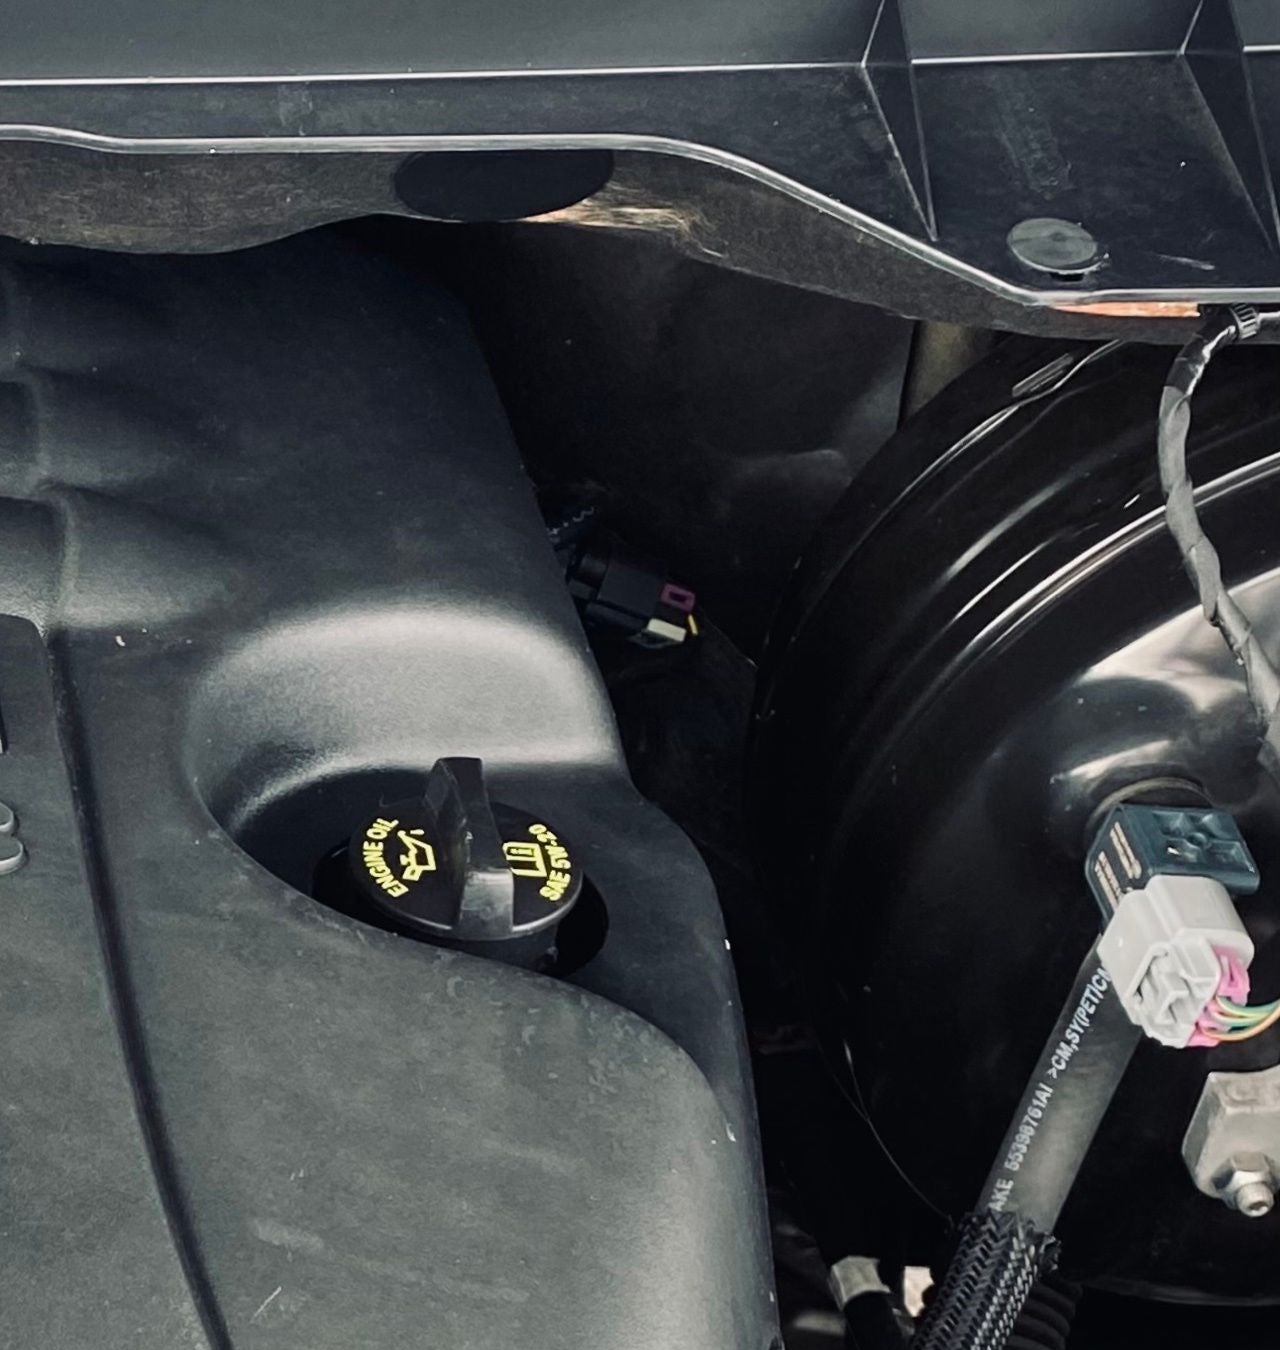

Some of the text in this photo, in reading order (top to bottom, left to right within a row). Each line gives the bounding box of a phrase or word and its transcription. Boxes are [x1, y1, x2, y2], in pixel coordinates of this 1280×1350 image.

[362, 817, 410, 898] ENGINE OIL
[528, 823, 572, 901] SAE 5W-20
